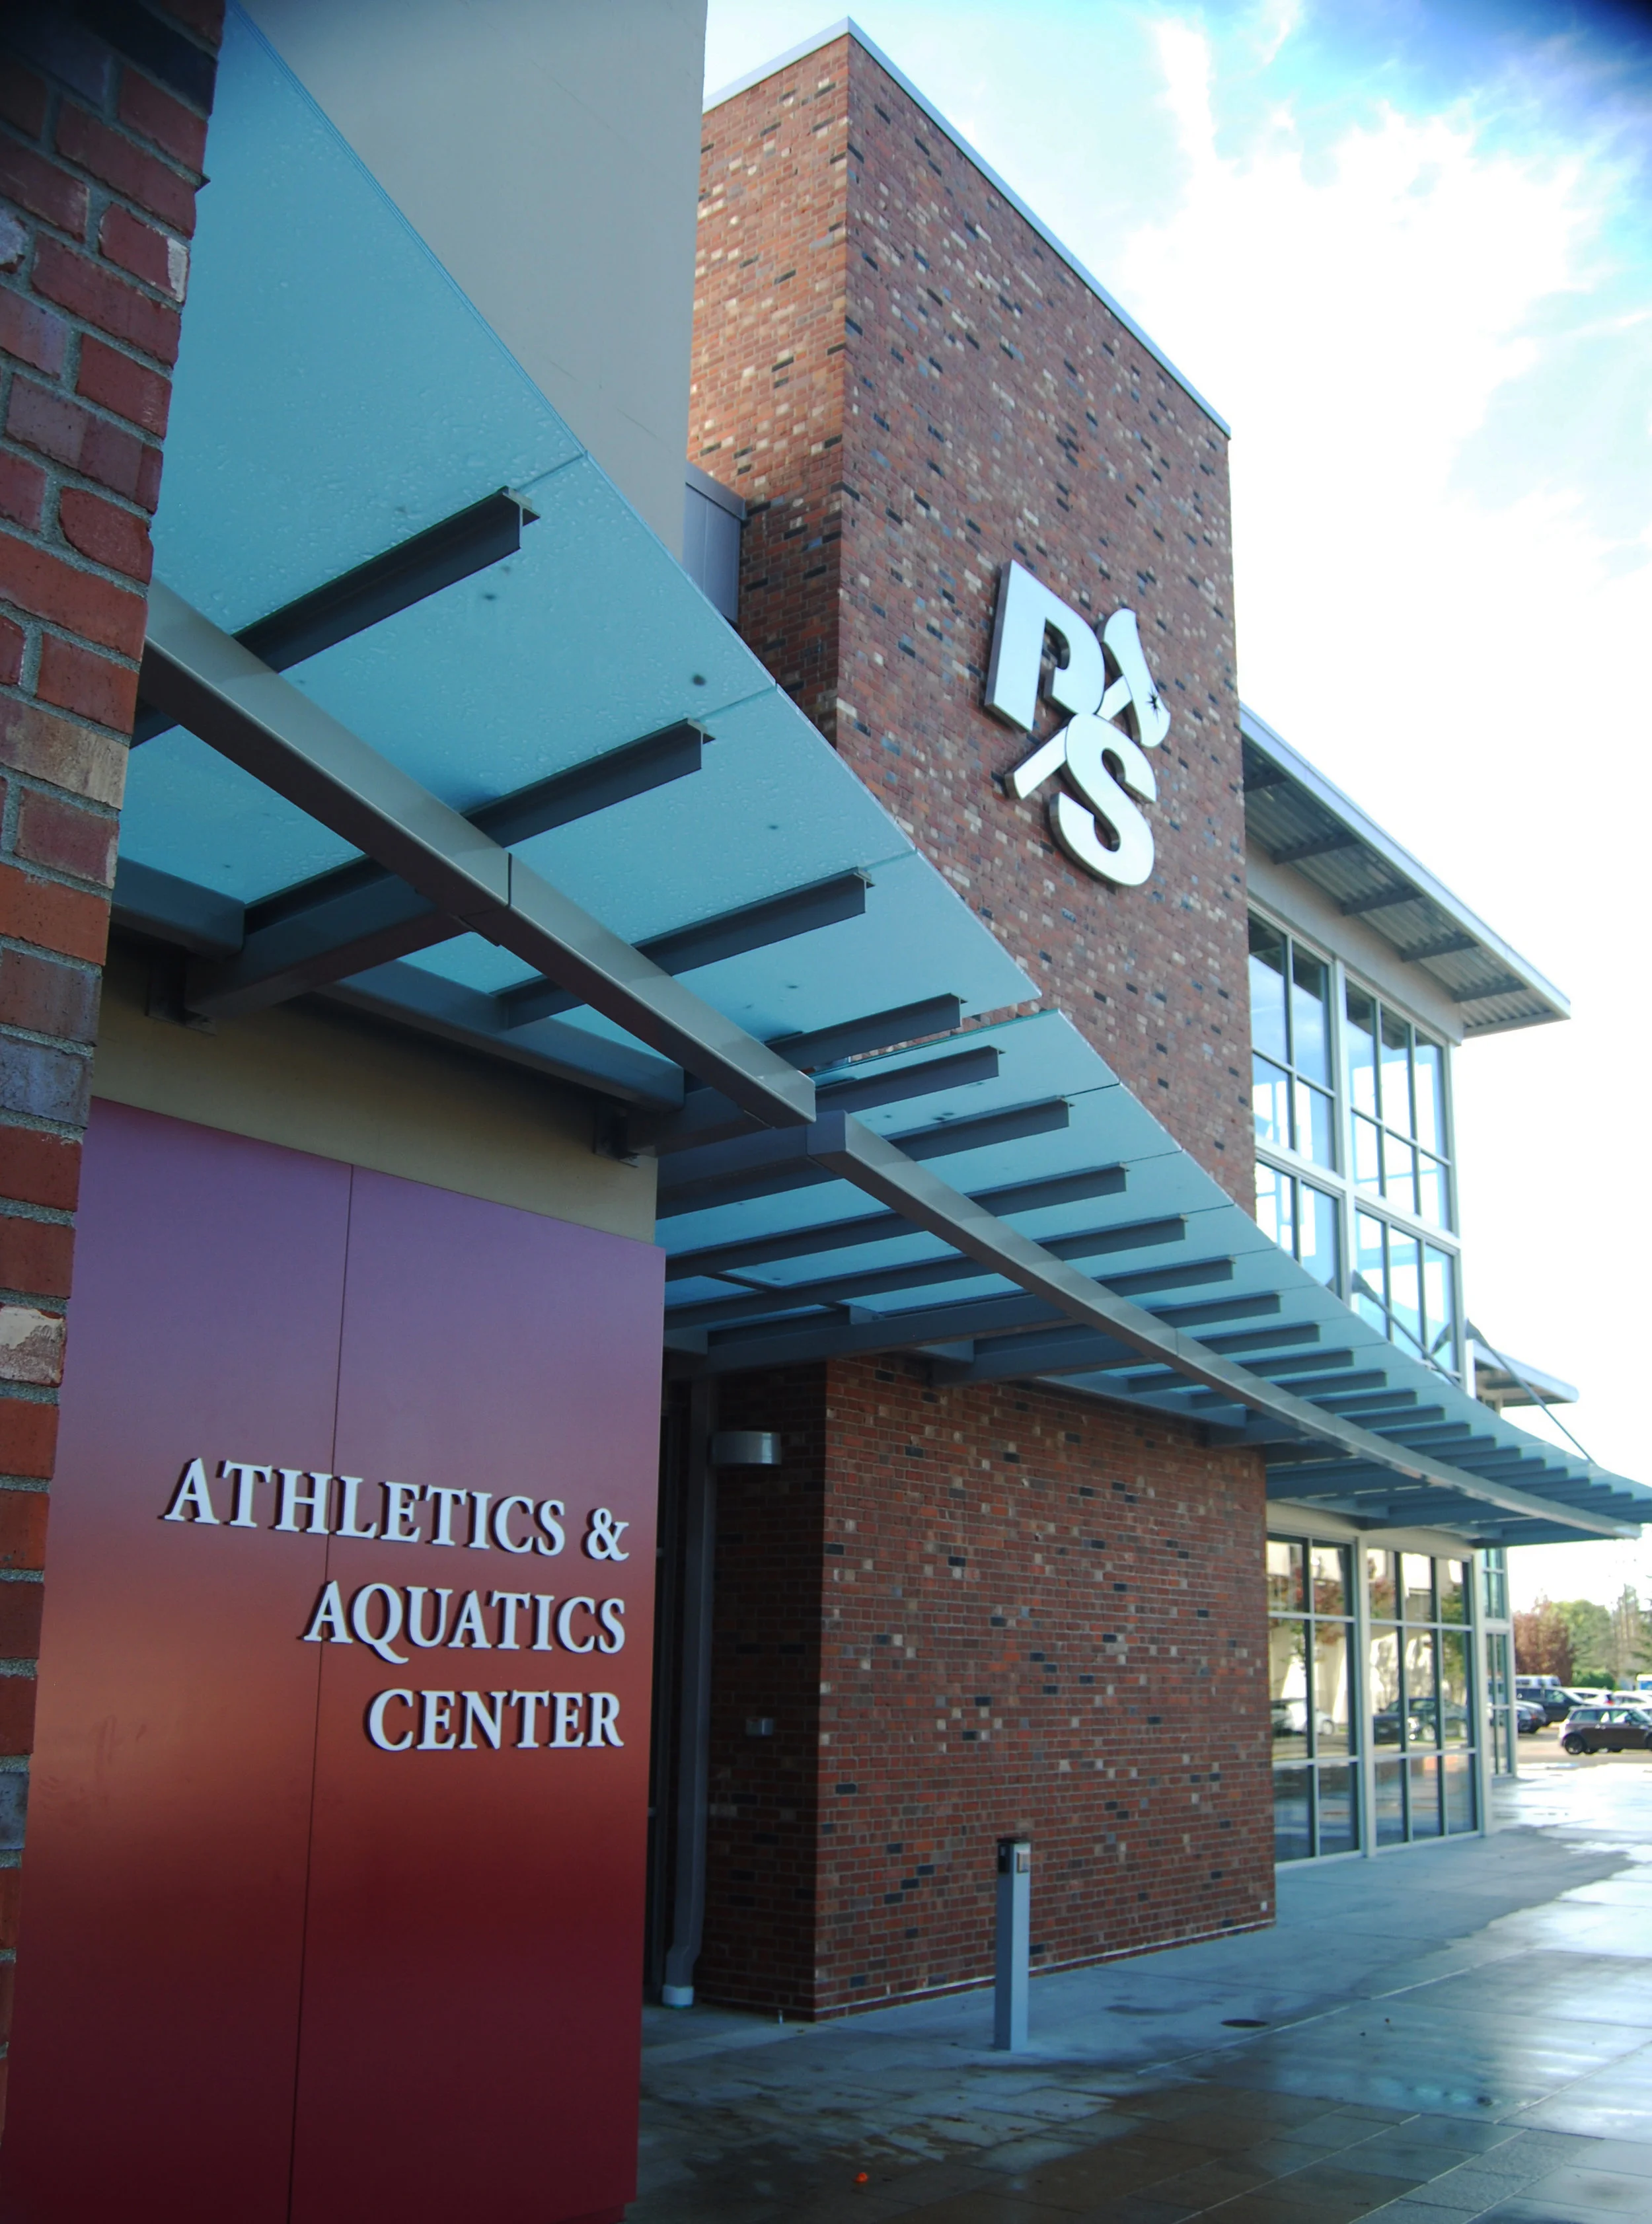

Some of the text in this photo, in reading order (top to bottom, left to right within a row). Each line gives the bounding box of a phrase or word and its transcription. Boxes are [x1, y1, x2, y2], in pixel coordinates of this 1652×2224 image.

[163, 1458, 630, 1561] ATHLETICS &
[301, 1580, 626, 1664] AQUATICS
[366, 1689, 625, 1751] CENTER
